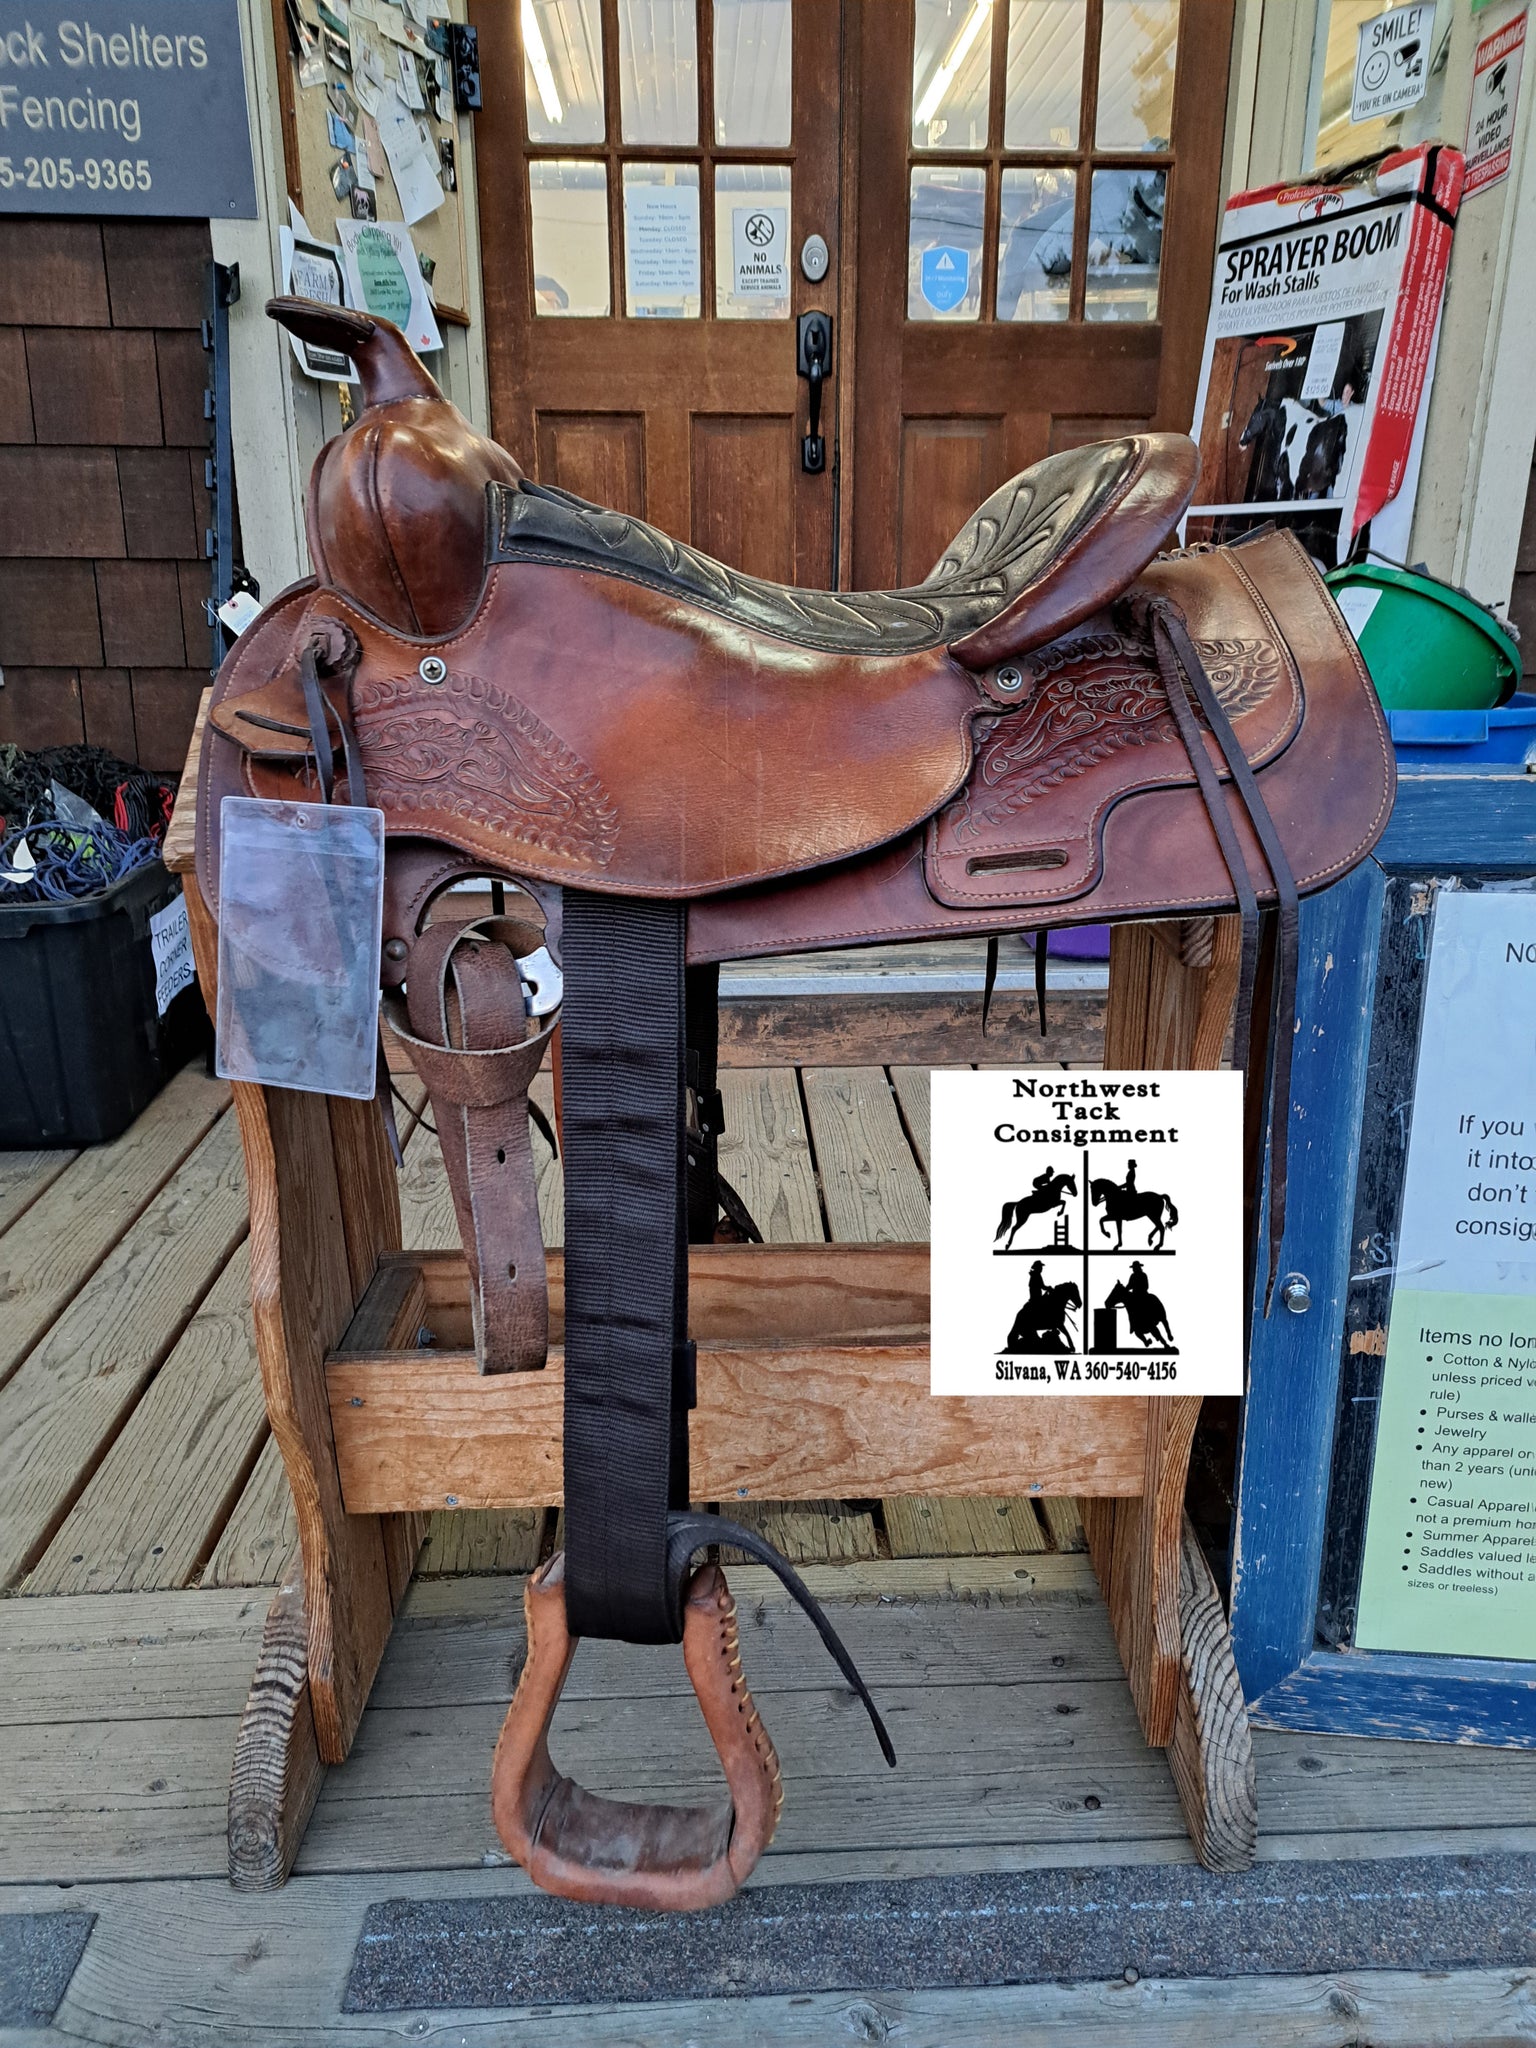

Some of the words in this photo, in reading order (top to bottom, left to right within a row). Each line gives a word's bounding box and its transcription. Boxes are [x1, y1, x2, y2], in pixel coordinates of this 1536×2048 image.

[1372, 8, 1422, 48] SMILE!
[57, 20, 209, 68] Shelters
[1478, 23, 1526, 67] WARNING
[1382, 92, 1392, 105] ON
[0, 84, 142, 142] Fencing
[1475, 118, 1485, 135] 24
[1487, 102, 1508, 128] HOUR
[1479, 125, 1501, 148] VIDEO
[1465, 134, 1511, 172] SURVEILLANCE
[753, 252, 767, 262] NO
[1224, 233, 1329, 284] SPRAYER
[1332, 212, 1402, 264] BOOM
[740, 264, 782, 275] ANIMALS
[1221, 286, 1243, 305] For
[1245, 277, 1281, 301] Wash
[1283, 270, 1320, 294] Stalls
[154, 910, 188, 950] TRAILER
[159, 937, 188, 979] CORNER
[157, 962, 192, 1009] FEEDERS
[1459, 1114, 1476, 1134] If
[1480, 1120, 1524, 1140] you
[1468, 1148, 1481, 1168] it
[1489, 1149, 1533, 1171] into
[1468, 1182, 1527, 1204] don't
[1456, 1217, 1536, 1241] consig
[1419, 1328, 1472, 1346] Items
[1479, 1334, 1503, 1347] no
[1443, 1353, 1489, 1367] Cotton
[1493, 1356, 1503, 1368] &
[1432, 1372, 1477, 1385] unless
[1480, 1374, 1523, 1388] priced
[1429, 1389, 1462, 1404] rule)
[1437, 1406, 1485, 1421] Purses
[1488, 1410, 1498, 1422] &
[1434, 1424, 1488, 1442] Jewelry
[1432, 1442, 1459, 1456] Any
[1462, 1447, 1514, 1459] apparel
[1421, 1459, 1450, 1472] than
[1455, 1461, 1464, 1473] 2
[1467, 1464, 1505, 1476] years
[1420, 1478, 1453, 1492] new)
[1427, 1495, 1474, 1509] Casual
[1477, 1499, 1530, 1513] Apparel
[1416, 1513, 1437, 1524] not
[1440, 1515, 1449, 1525] a
[1453, 1516, 1511, 1528] premium
[1422, 1530, 1479, 1543] Summer
[1482, 1532, 1534, 1547] Apparel
[1420, 1546, 1474, 1559] Saddles
[1478, 1550, 1523, 1563] valued
[1418, 1562, 1472, 1577] Saddles
[1476, 1567, 1524, 1581] without
[1407, 1578, 1435, 1589] sizes
[1438, 1582, 1449, 1590] or
[1452, 1583, 1499, 1596] treeless)
